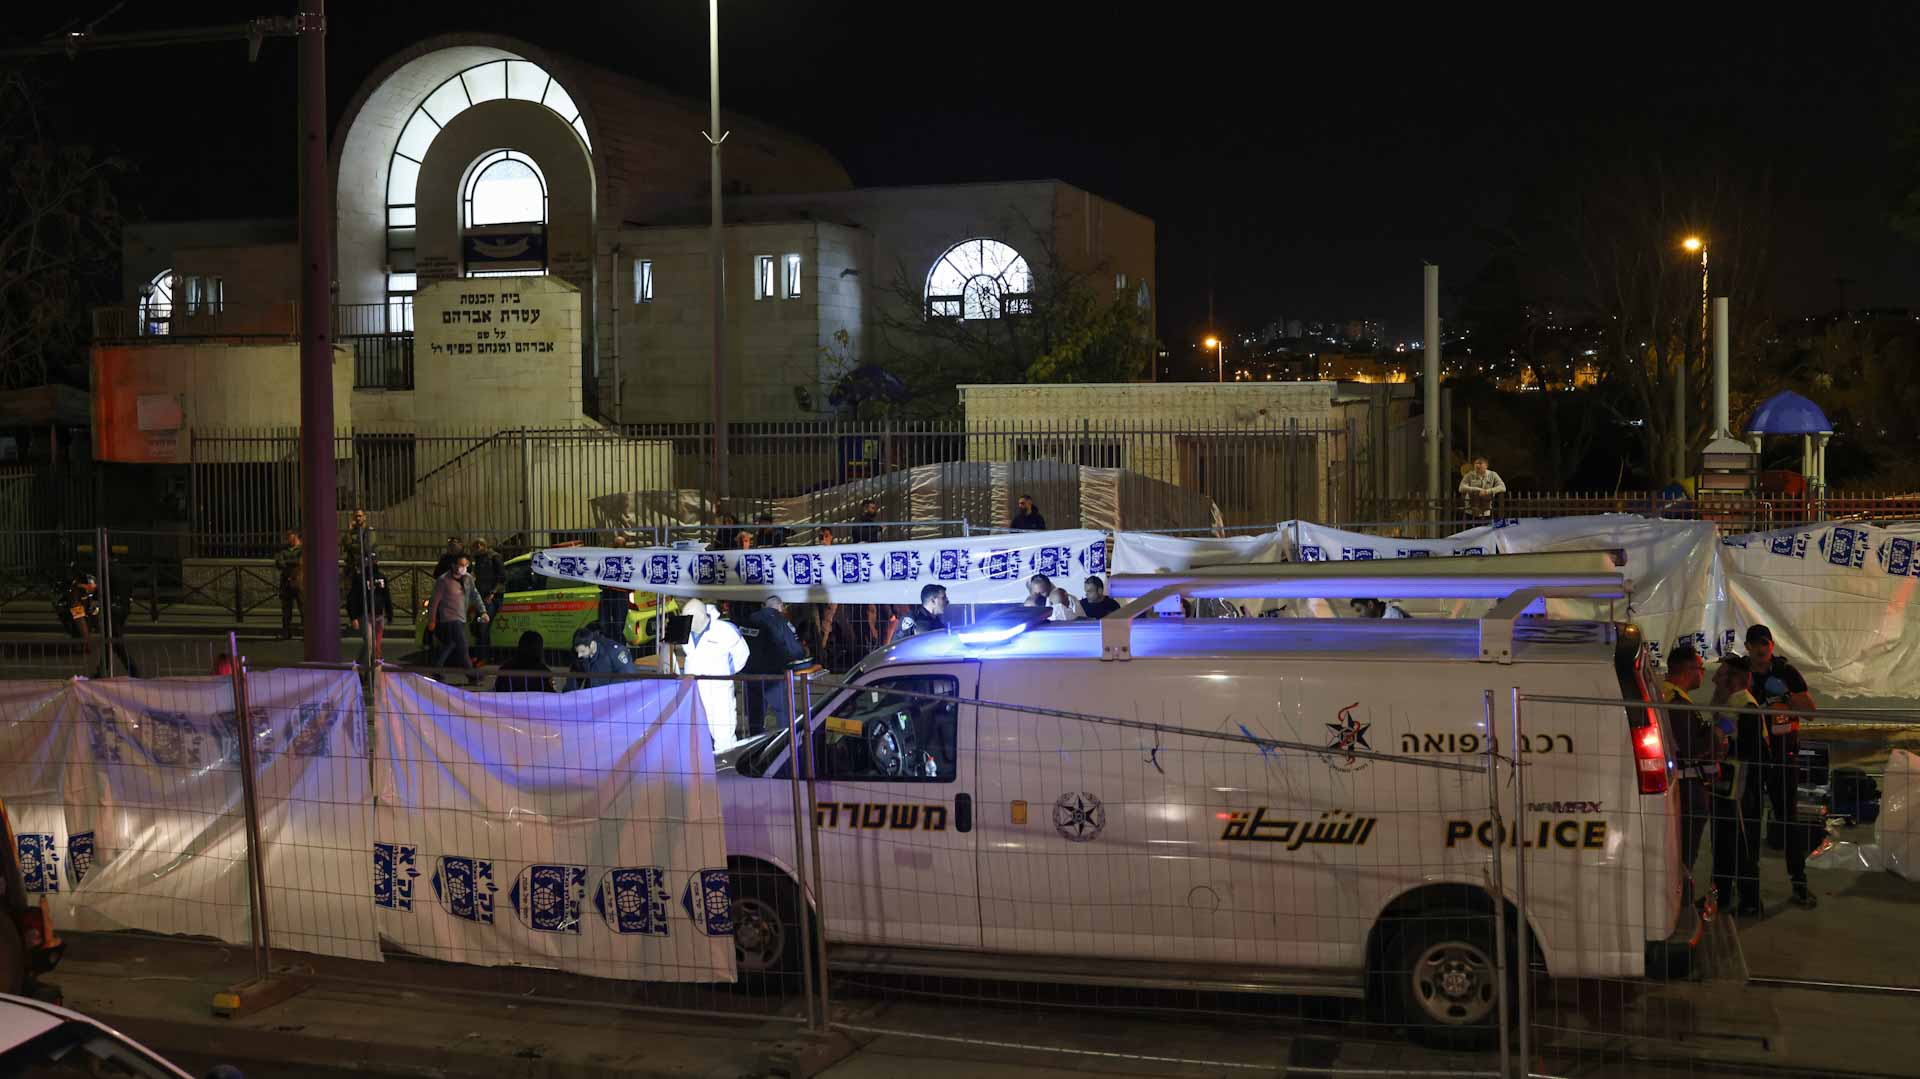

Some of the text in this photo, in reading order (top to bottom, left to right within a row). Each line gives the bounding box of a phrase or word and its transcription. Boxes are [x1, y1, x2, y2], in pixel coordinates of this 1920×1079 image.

[460, 293, 520, 305] בית הכנסת
[442, 309, 540, 324] עטרת אברהם
[477, 328, 506, 339] על שם
[478, 342, 511, 353] ומנחם
[515, 341, 554, 353] אברהם
[1401, 733, 1499, 754] פואה
[815, 802, 948, 831] משטרה
[1221, 807, 1377, 851] الشرطة
[1446, 820, 1607, 848] POLICE
